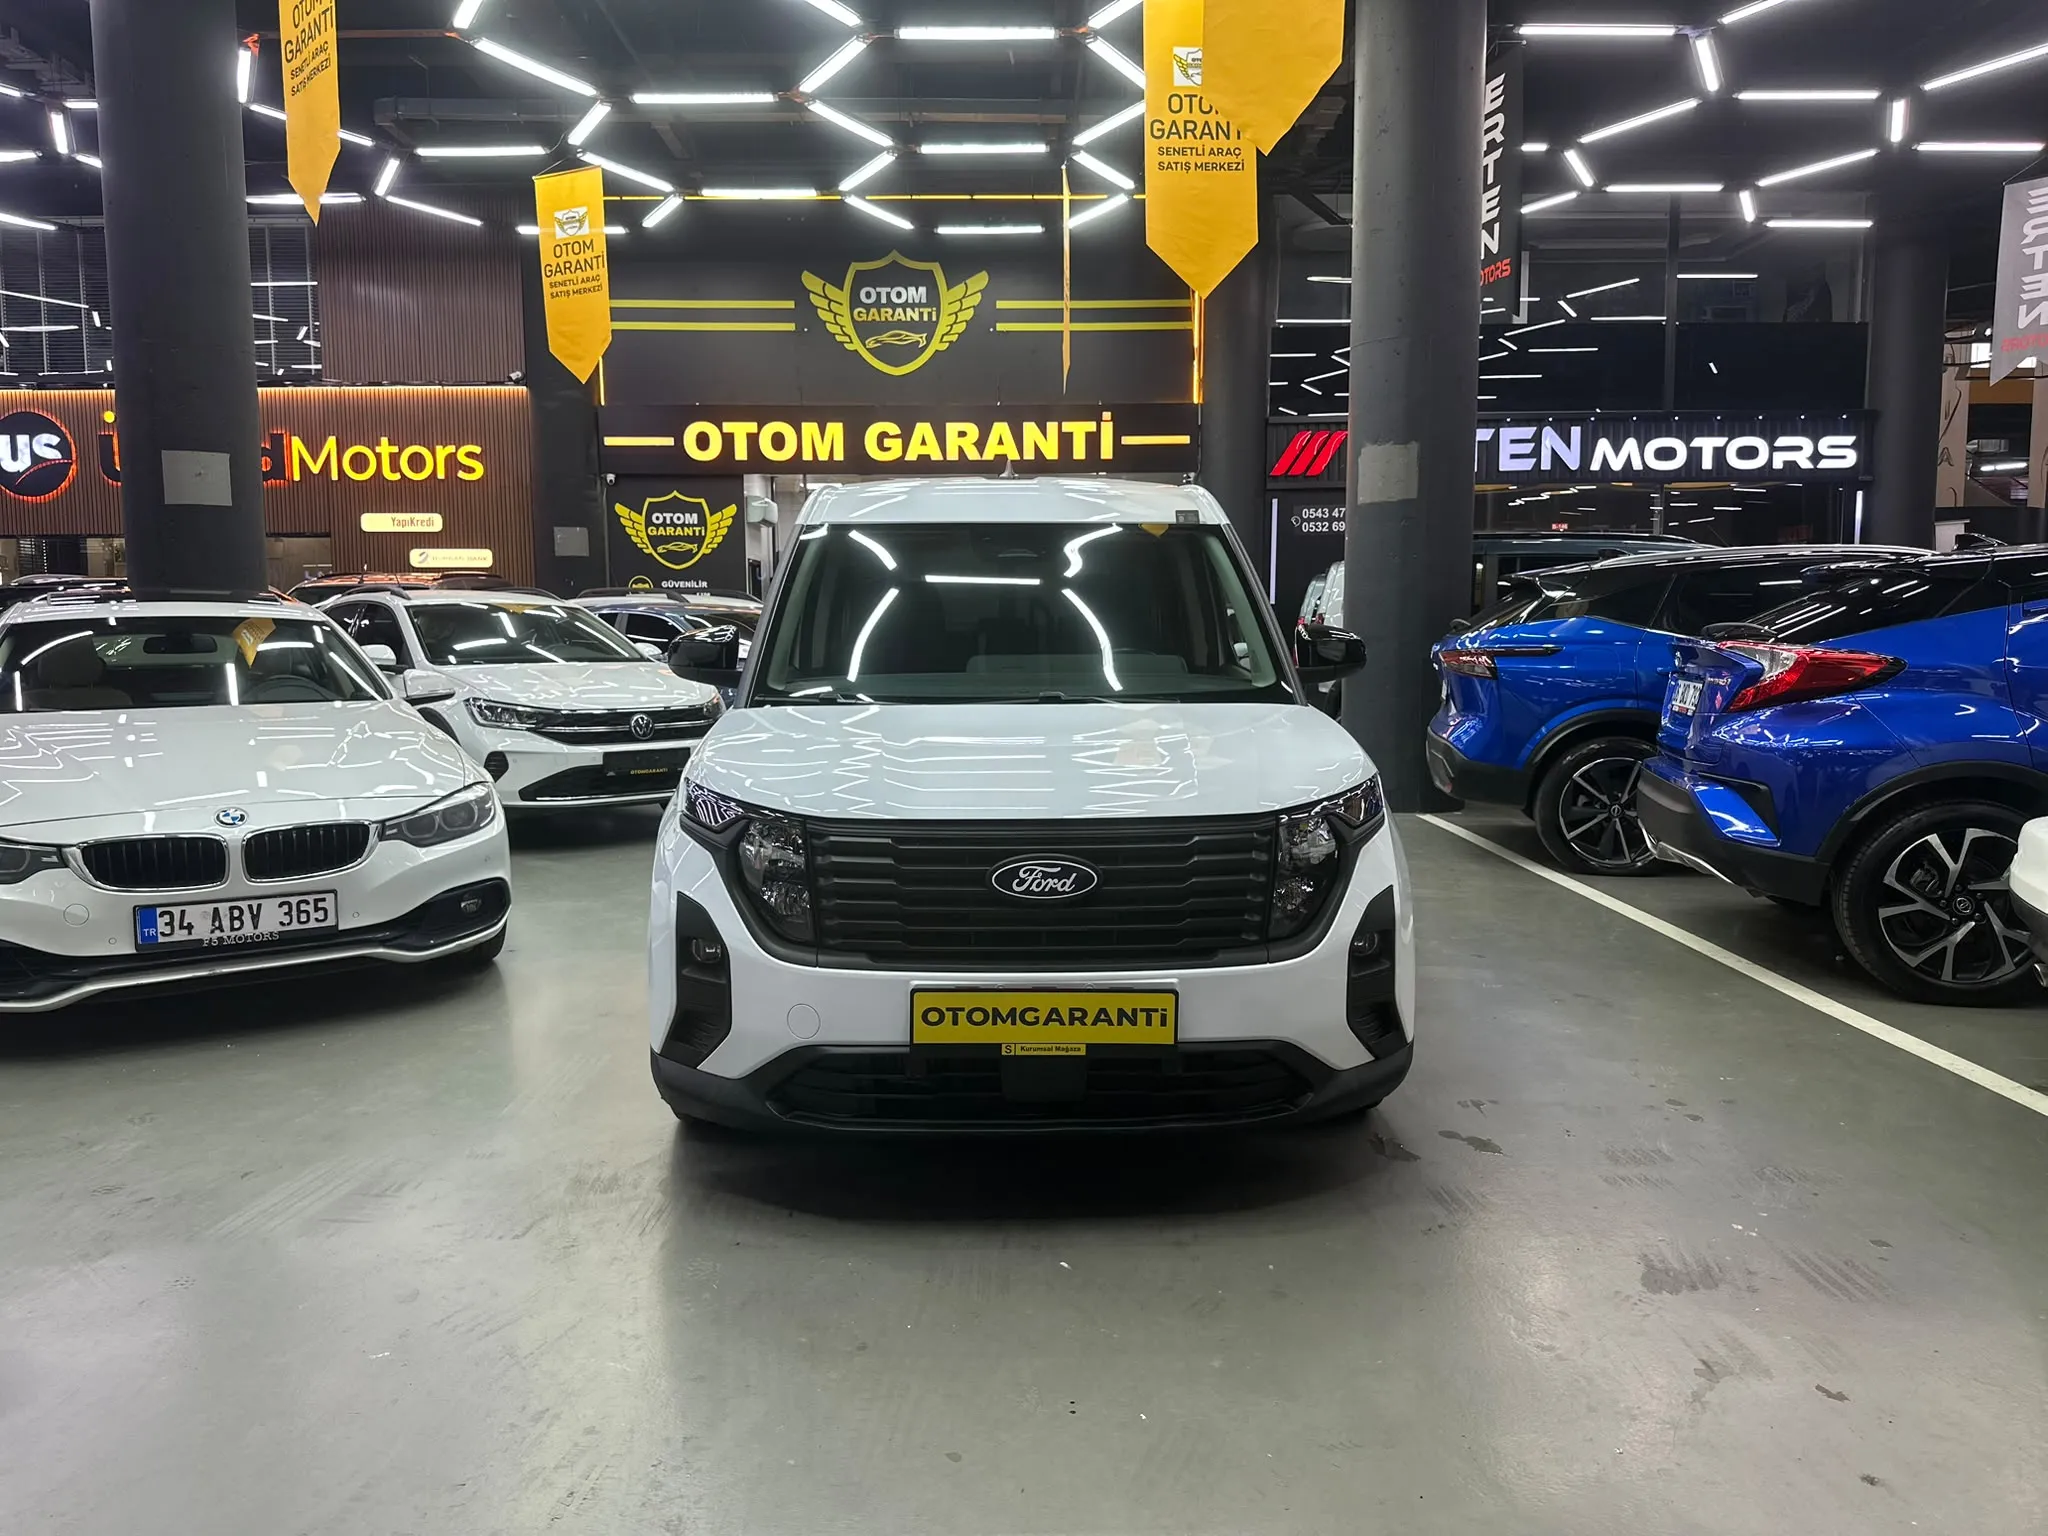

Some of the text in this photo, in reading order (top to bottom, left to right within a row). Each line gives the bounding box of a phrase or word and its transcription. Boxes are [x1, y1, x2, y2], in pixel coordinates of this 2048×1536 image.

[1167, 93, 1219, 115] OTO
[1149, 118, 1242, 141] GARAN
[1157, 144, 1242, 160] SENETLİ ARAÇ
[1157, 158, 1245, 174] SATIŞ MERKEZİ
[1480, 72, 1507, 260] ERTEN
[552, 238, 595, 259] OTOM
[543, 250, 606, 279] GARANTİ
[549, 274, 601, 290] SENETLİ ARAÇ
[550, 283, 603, 300] SATIŞ MERKEZİ
[859, 286, 928, 305] OTOM
[682, 410, 1114, 463] OTOM GARANTİ
[1590, 435, 1858, 471] MOTORS
[651, 512, 698, 525] OTOM
[1302, 507, 1330, 519] 0543
[391, 516, 435, 529] YapıKredi
[1301, 521, 1330, 533] 0532
[661, 578, 708, 589] GÜVENİLİR
[1012, 865, 1078, 892] Ford
[158, 896, 329, 938] 34 ABV 365
[143, 927, 157, 937] TR
[222, 930, 281, 946] MOTORS
